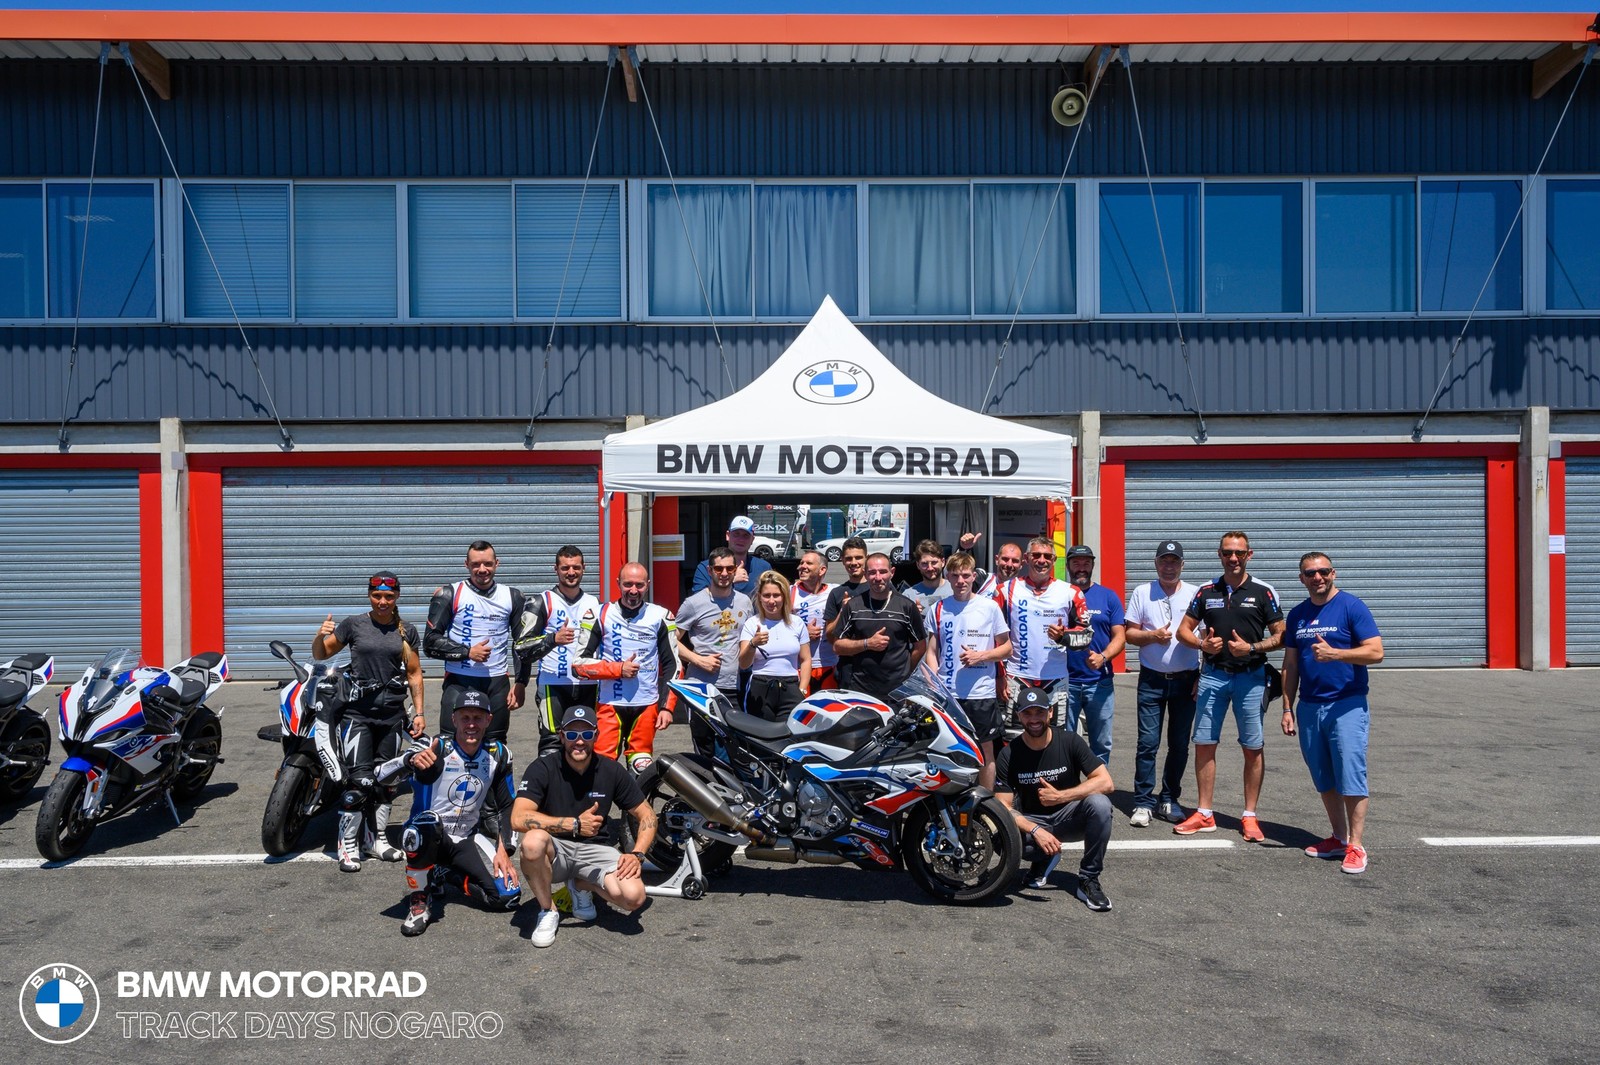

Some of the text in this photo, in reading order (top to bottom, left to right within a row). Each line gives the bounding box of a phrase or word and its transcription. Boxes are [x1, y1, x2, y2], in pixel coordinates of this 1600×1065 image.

[804, 363, 862, 377] BMW
[656, 444, 1020, 477] BMW MOTORRAD
[1018, 599, 1029, 671] TRACKDAYS
[1034, 766, 1068, 778] MOTORRAD
